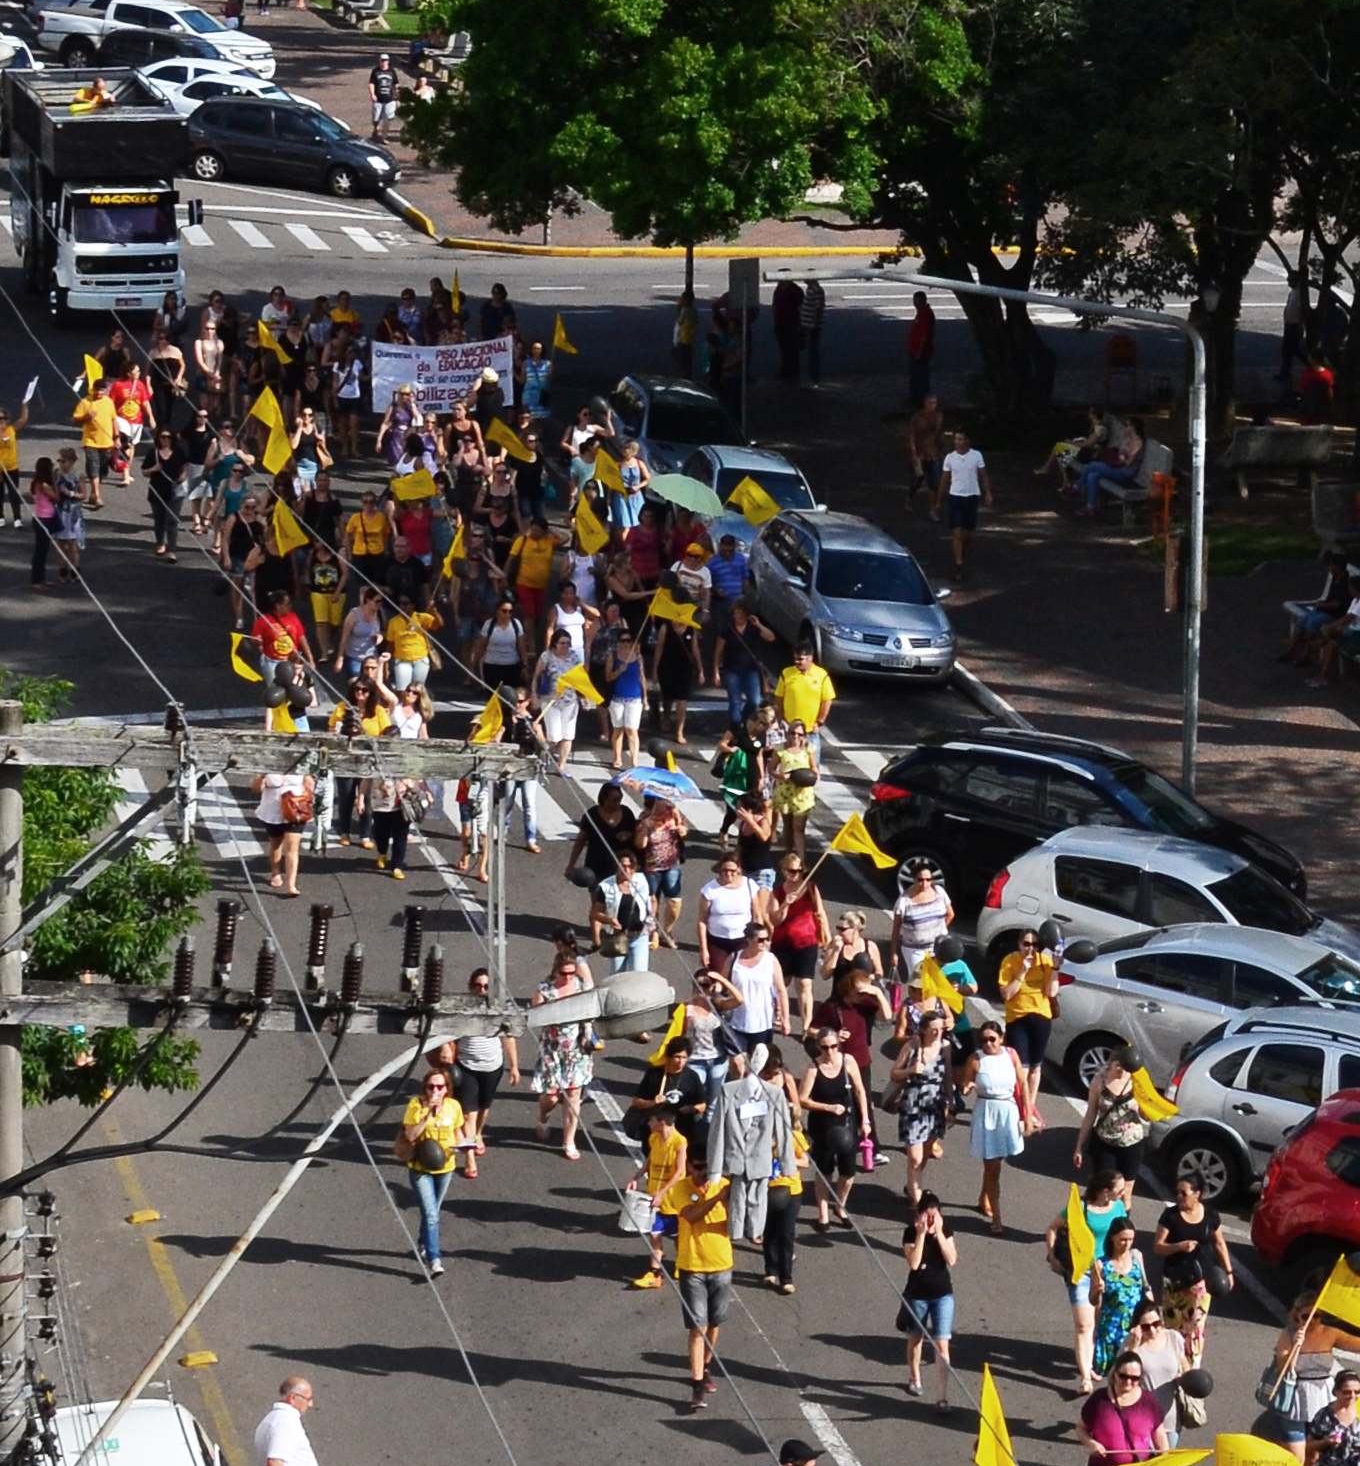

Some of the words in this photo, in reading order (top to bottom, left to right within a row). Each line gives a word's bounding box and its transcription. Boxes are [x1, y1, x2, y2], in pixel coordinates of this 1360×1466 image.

[435, 349, 458, 360] PISO
[460, 341, 508, 357] NACIONAL
[438, 357, 492, 373] EDUCAÇÃO
